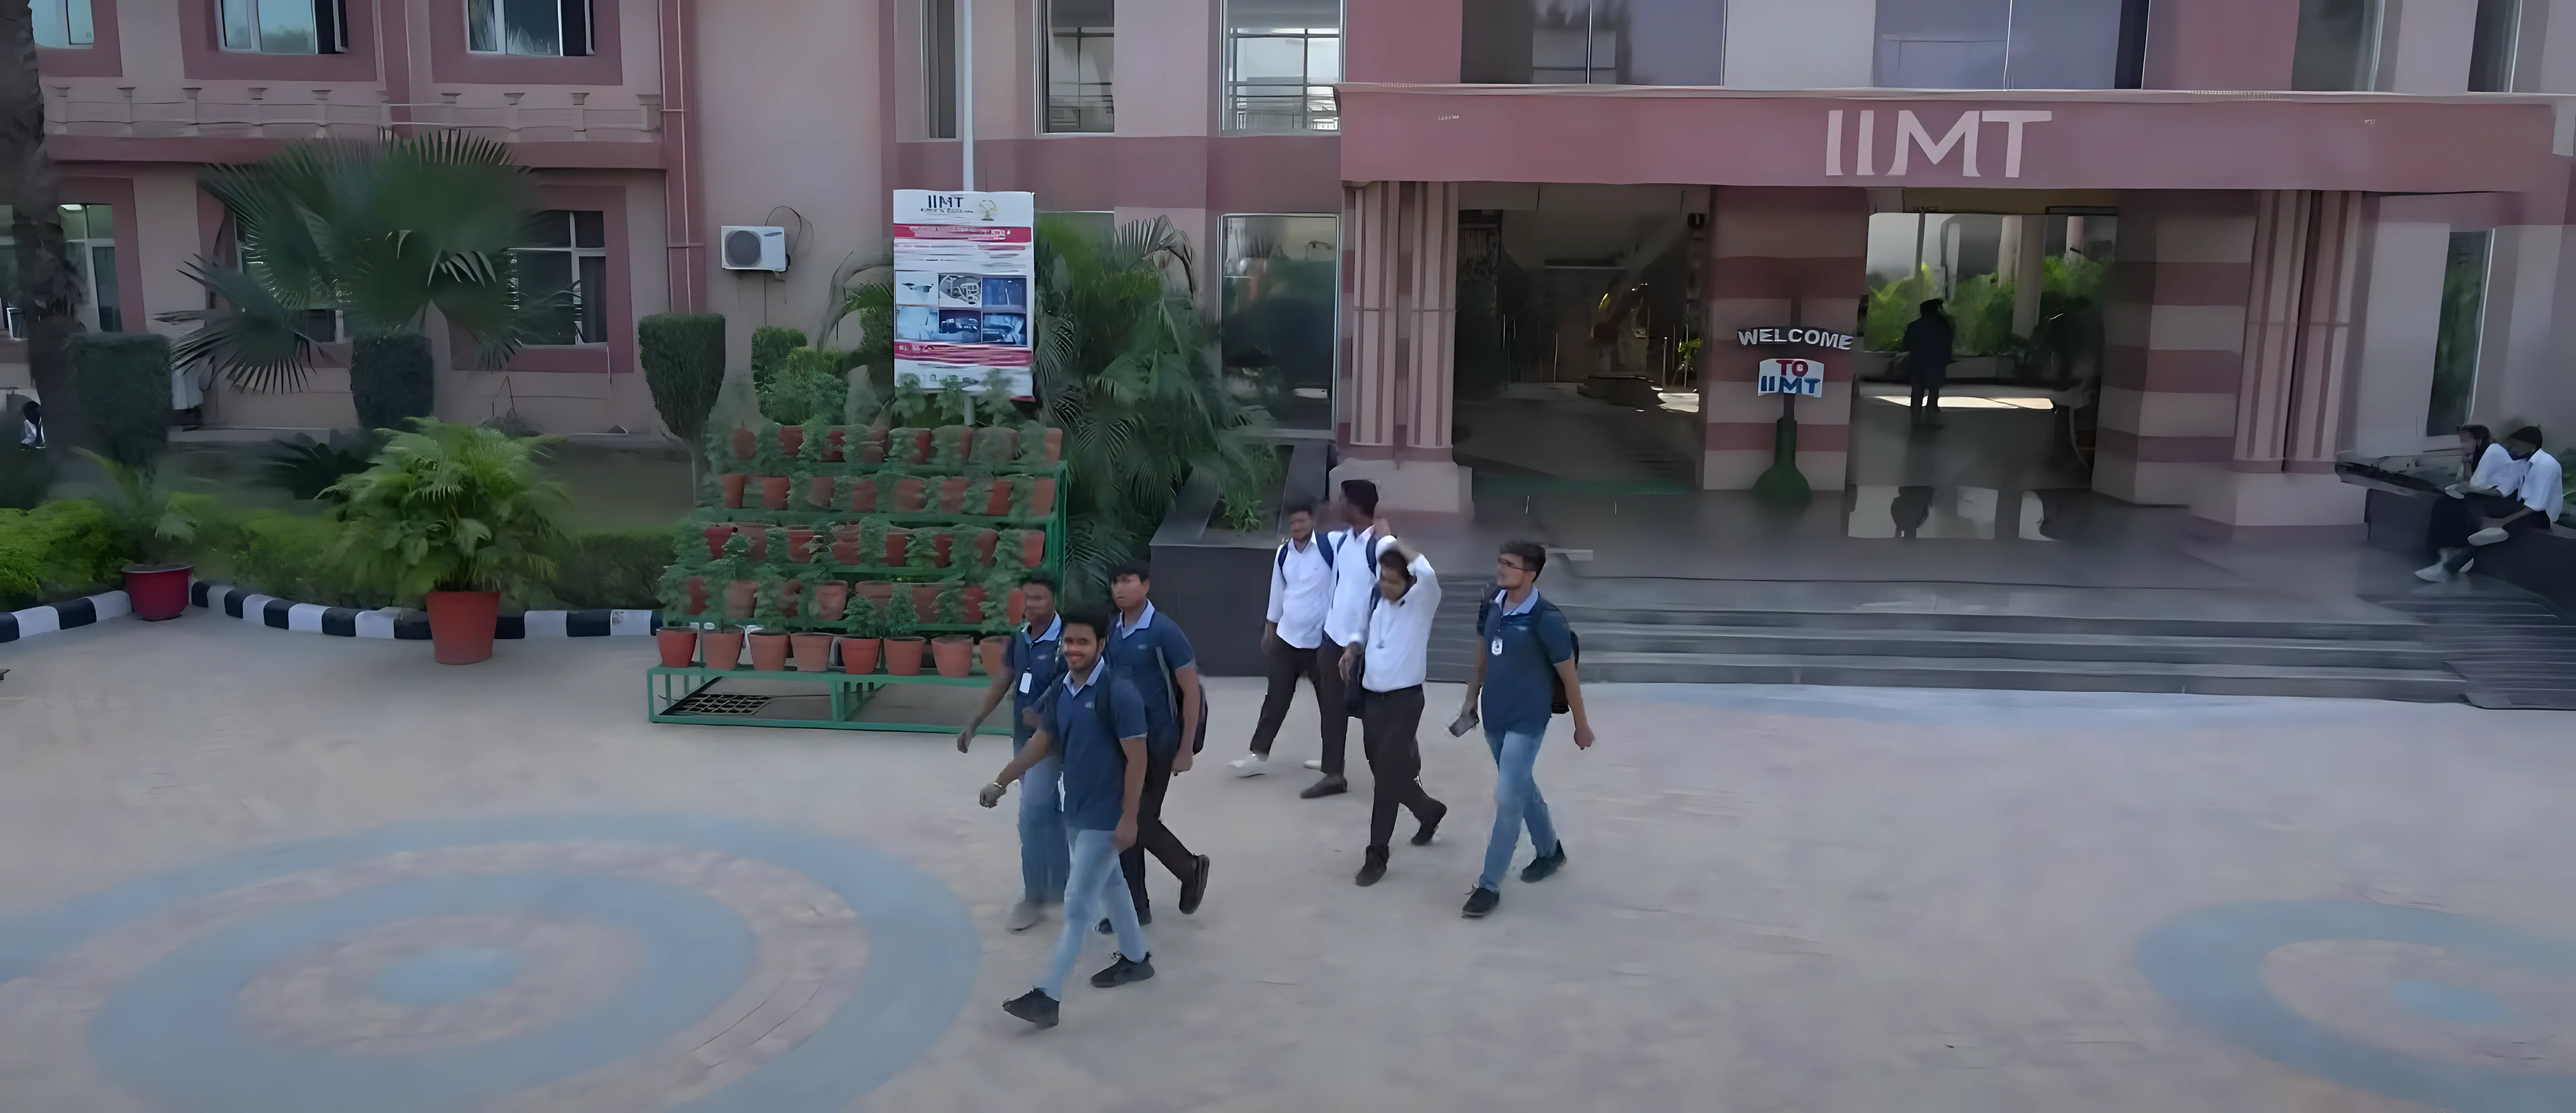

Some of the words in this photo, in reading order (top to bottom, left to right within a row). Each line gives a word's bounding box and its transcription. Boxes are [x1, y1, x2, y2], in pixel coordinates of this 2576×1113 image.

[1826, 110, 2052, 177] IIMT
[928, 195, 963, 208] IIMT
[1738, 329, 1853, 349] WELCOME
[1776, 360, 1808, 376] TO
[1761, 376, 1820, 393] IIMT
